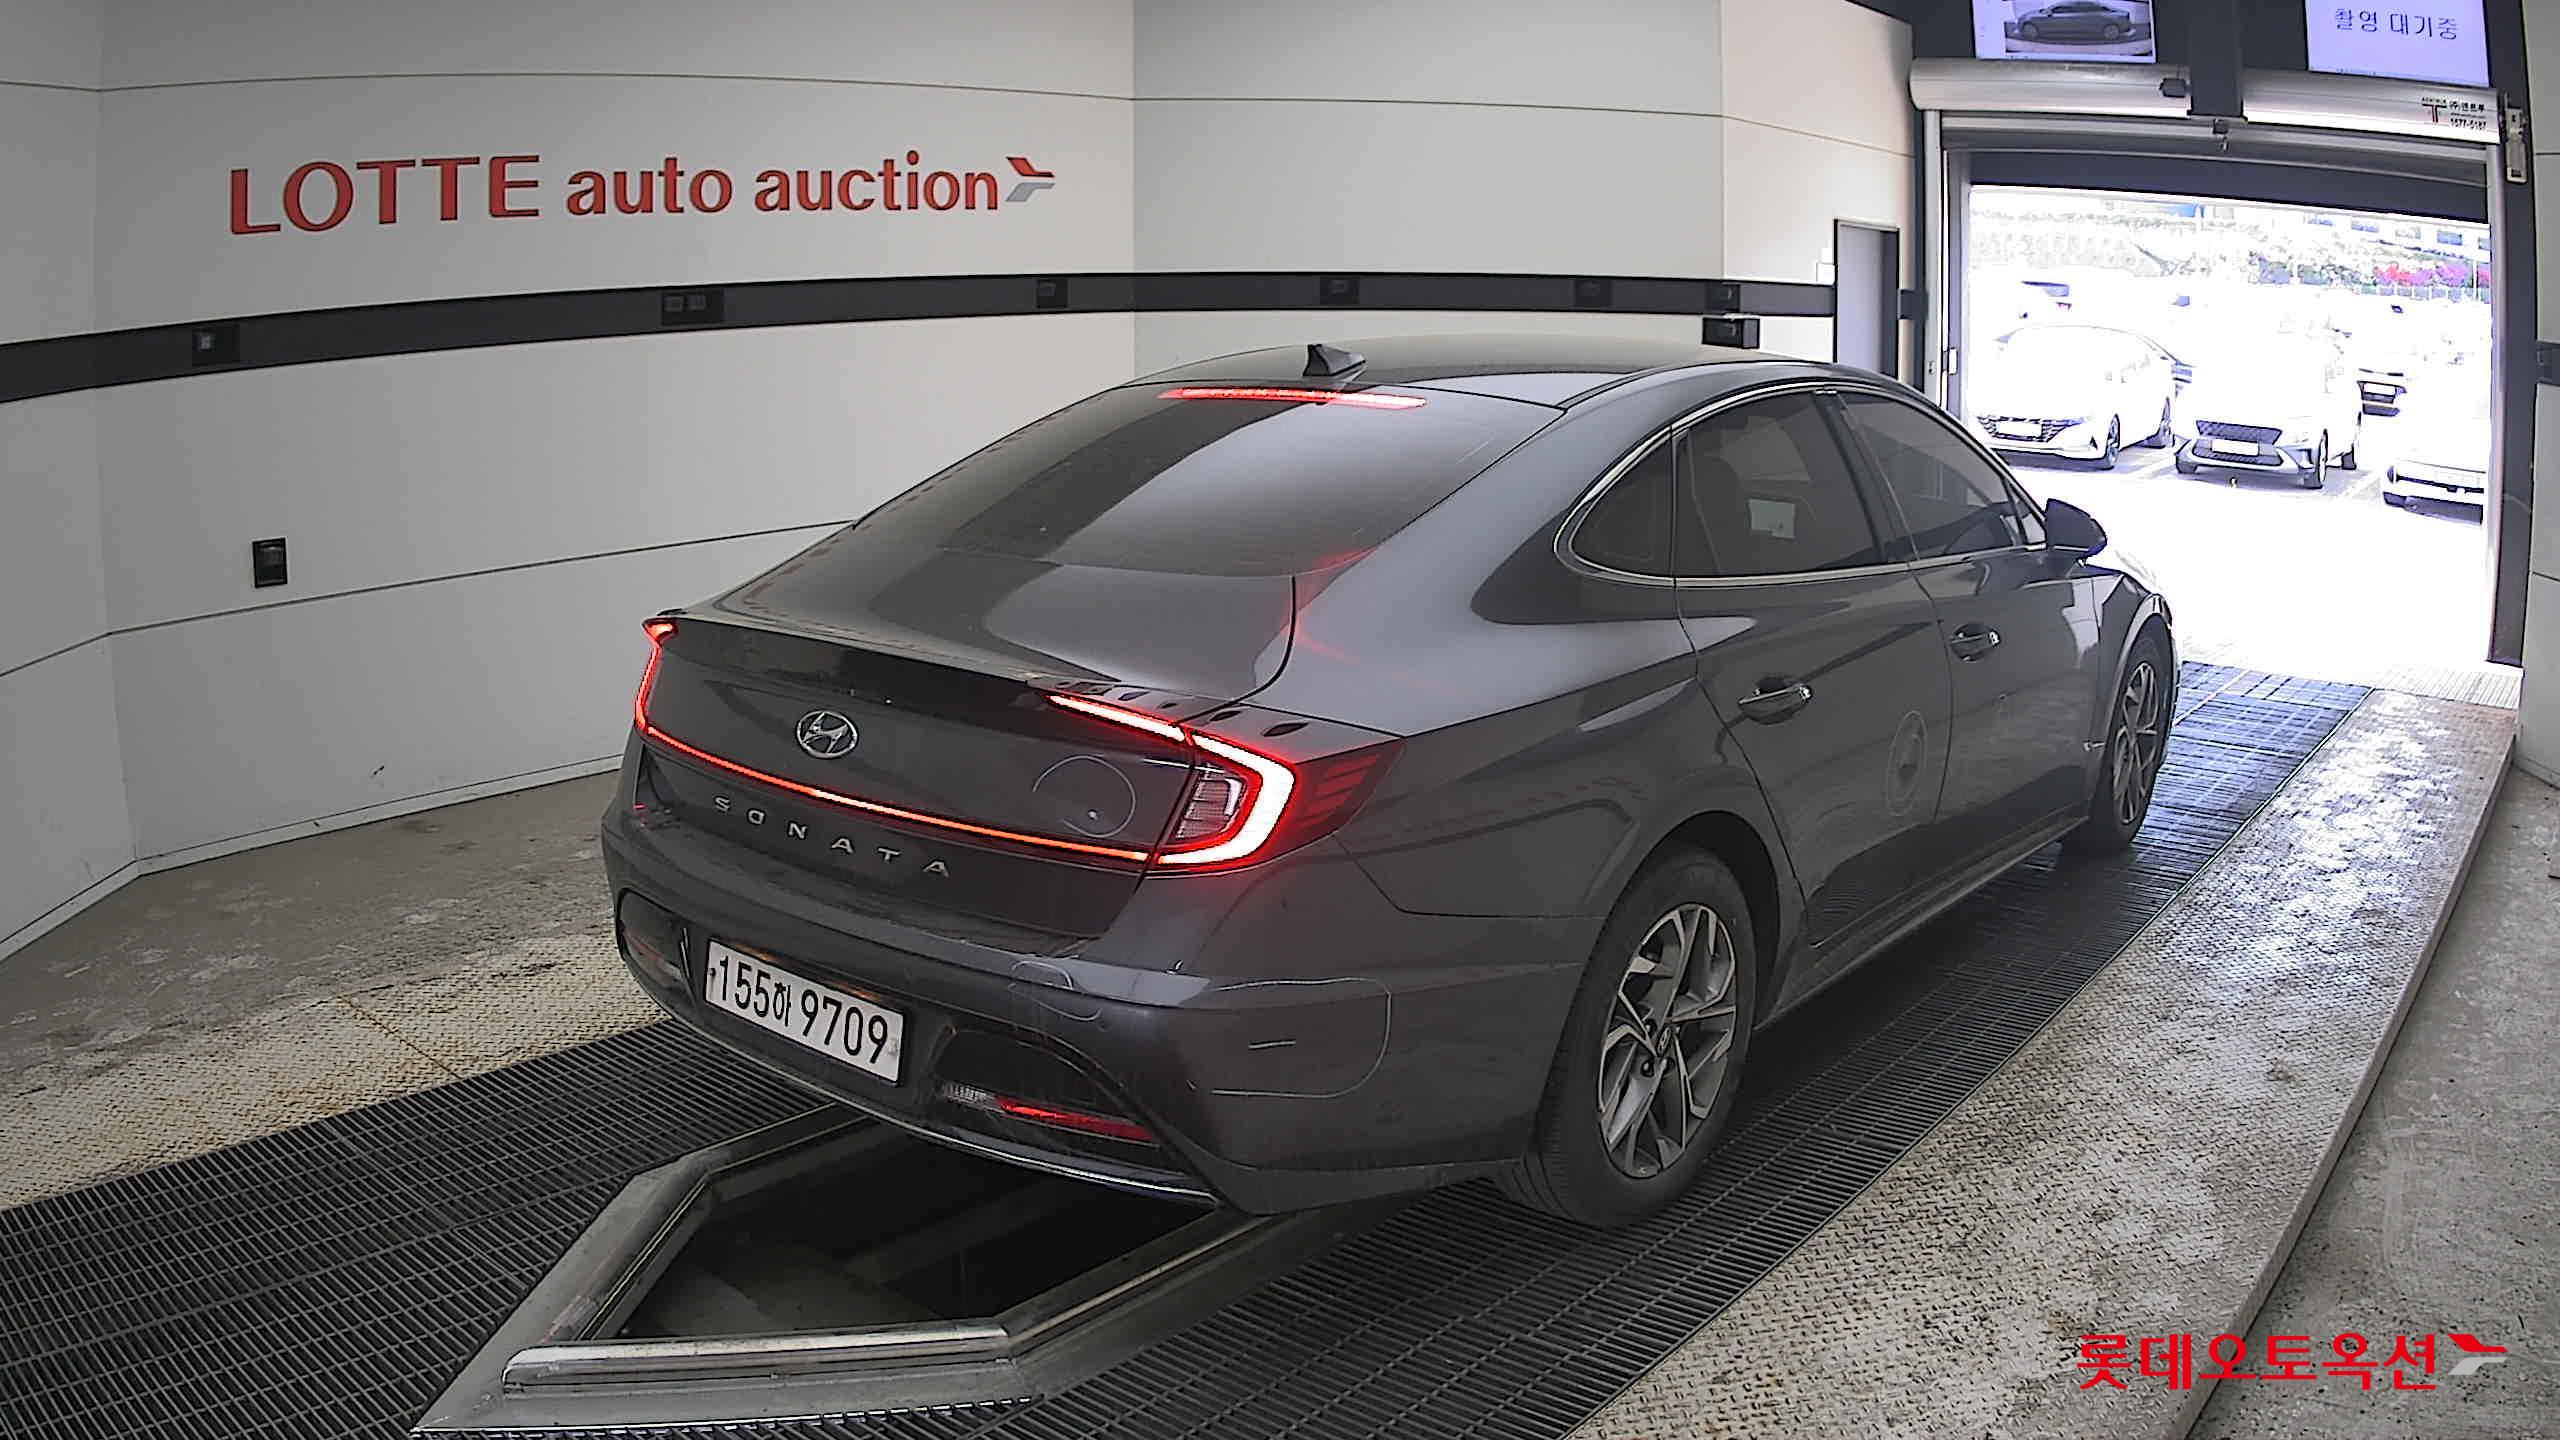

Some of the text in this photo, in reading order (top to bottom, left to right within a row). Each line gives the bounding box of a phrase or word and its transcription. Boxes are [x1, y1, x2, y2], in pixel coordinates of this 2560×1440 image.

[2335, 8, 2457, 40] 촬영 대기중
[230, 150, 999, 235] LOTTE auto auction
[713, 796, 949, 877] SONATA
[719, 955, 888, 1064] 155하 9709
